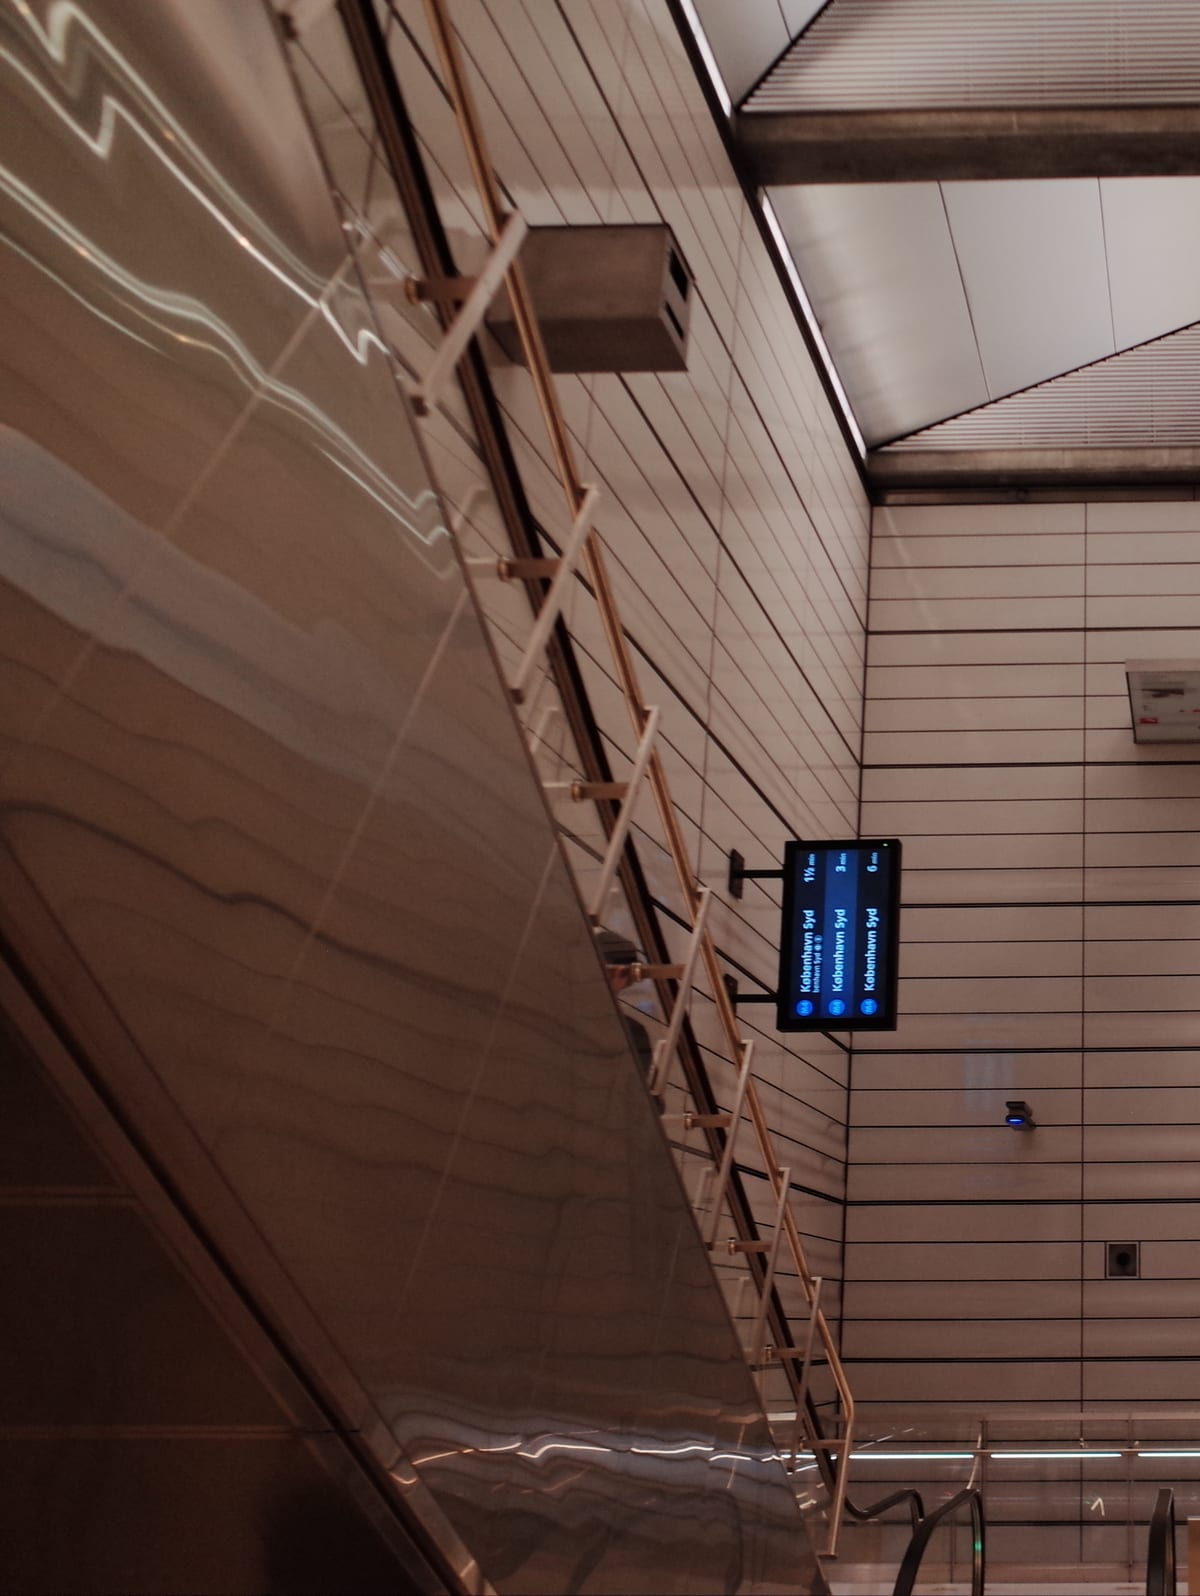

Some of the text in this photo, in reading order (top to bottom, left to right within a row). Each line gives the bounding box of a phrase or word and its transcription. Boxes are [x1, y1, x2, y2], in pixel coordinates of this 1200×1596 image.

[835, 864, 847, 873] 3
[839, 852, 847, 865] min
[866, 864, 878, 873] 6
[803, 909, 816, 929] Syd
[834, 908, 848, 928] Syd
[866, 907, 879, 928] Syd
[800, 931, 814, 993] København
[832, 930, 845, 992] København
[864, 930, 877, 992] København
